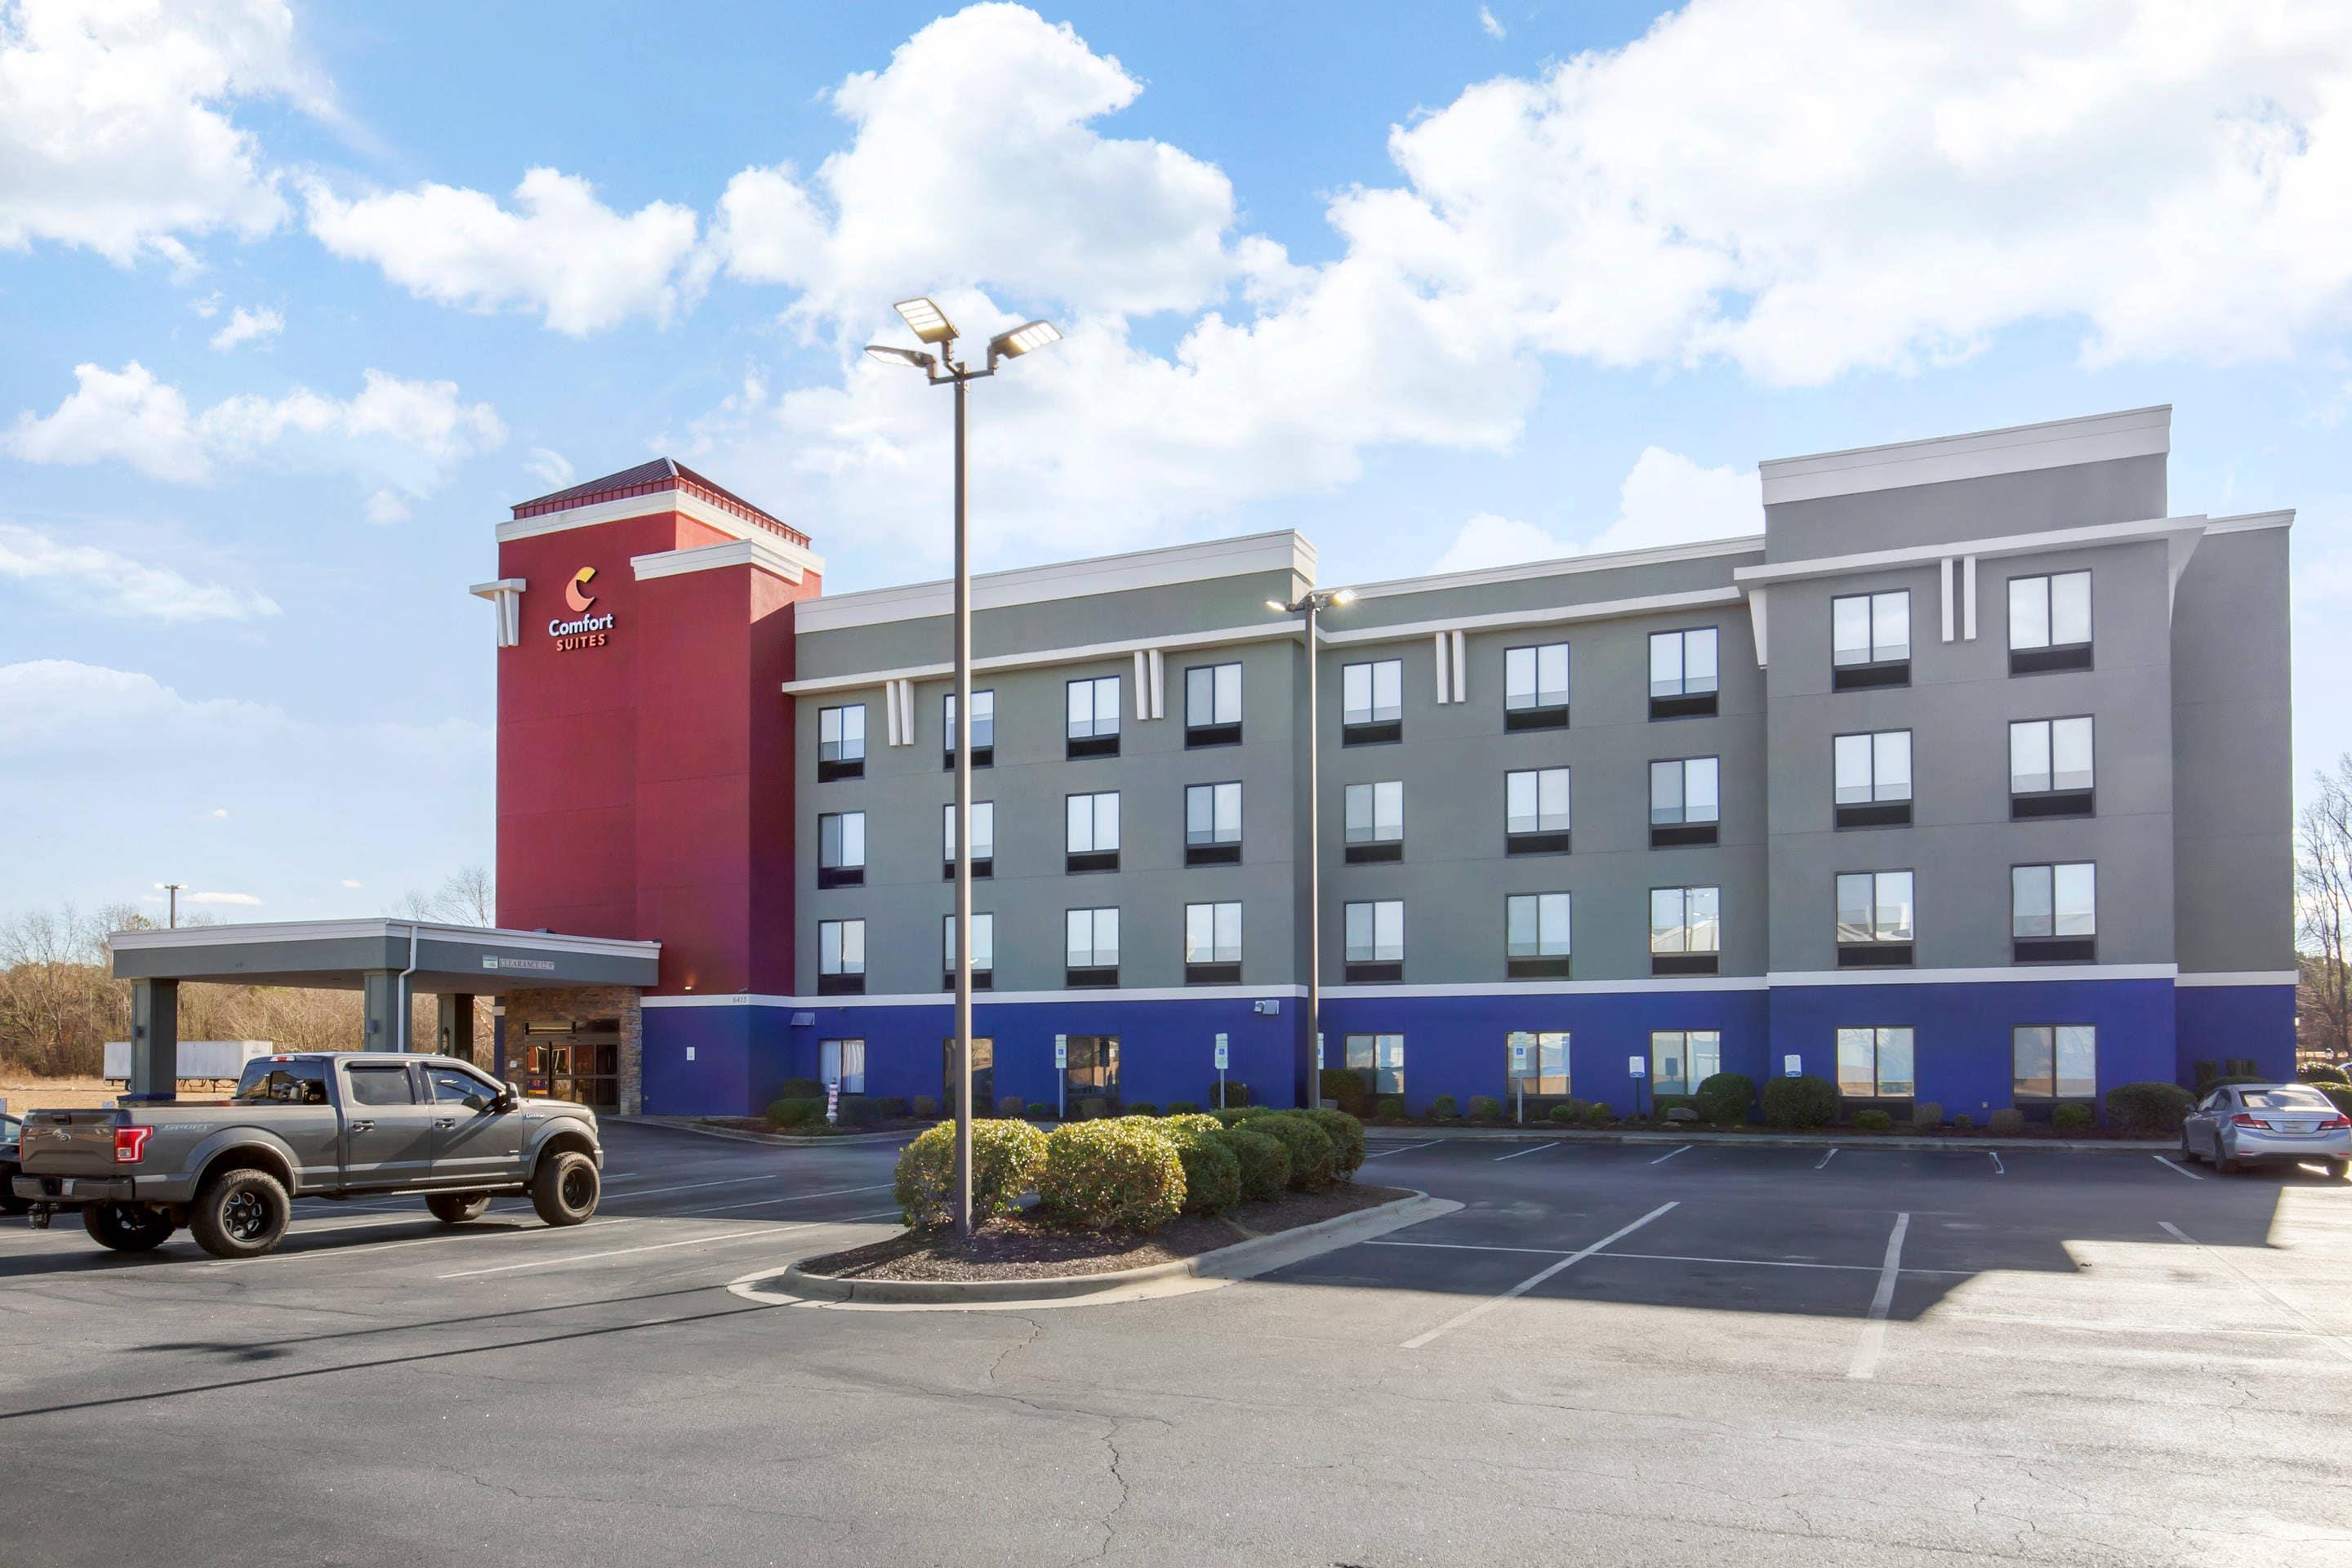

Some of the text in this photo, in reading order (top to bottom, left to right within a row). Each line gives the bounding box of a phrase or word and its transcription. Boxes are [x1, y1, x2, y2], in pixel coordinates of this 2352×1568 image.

[548, 613, 612, 636] Comfort
[556, 634, 605, 652] SUITES
[500, 960, 540, 968] CLEARANCE
